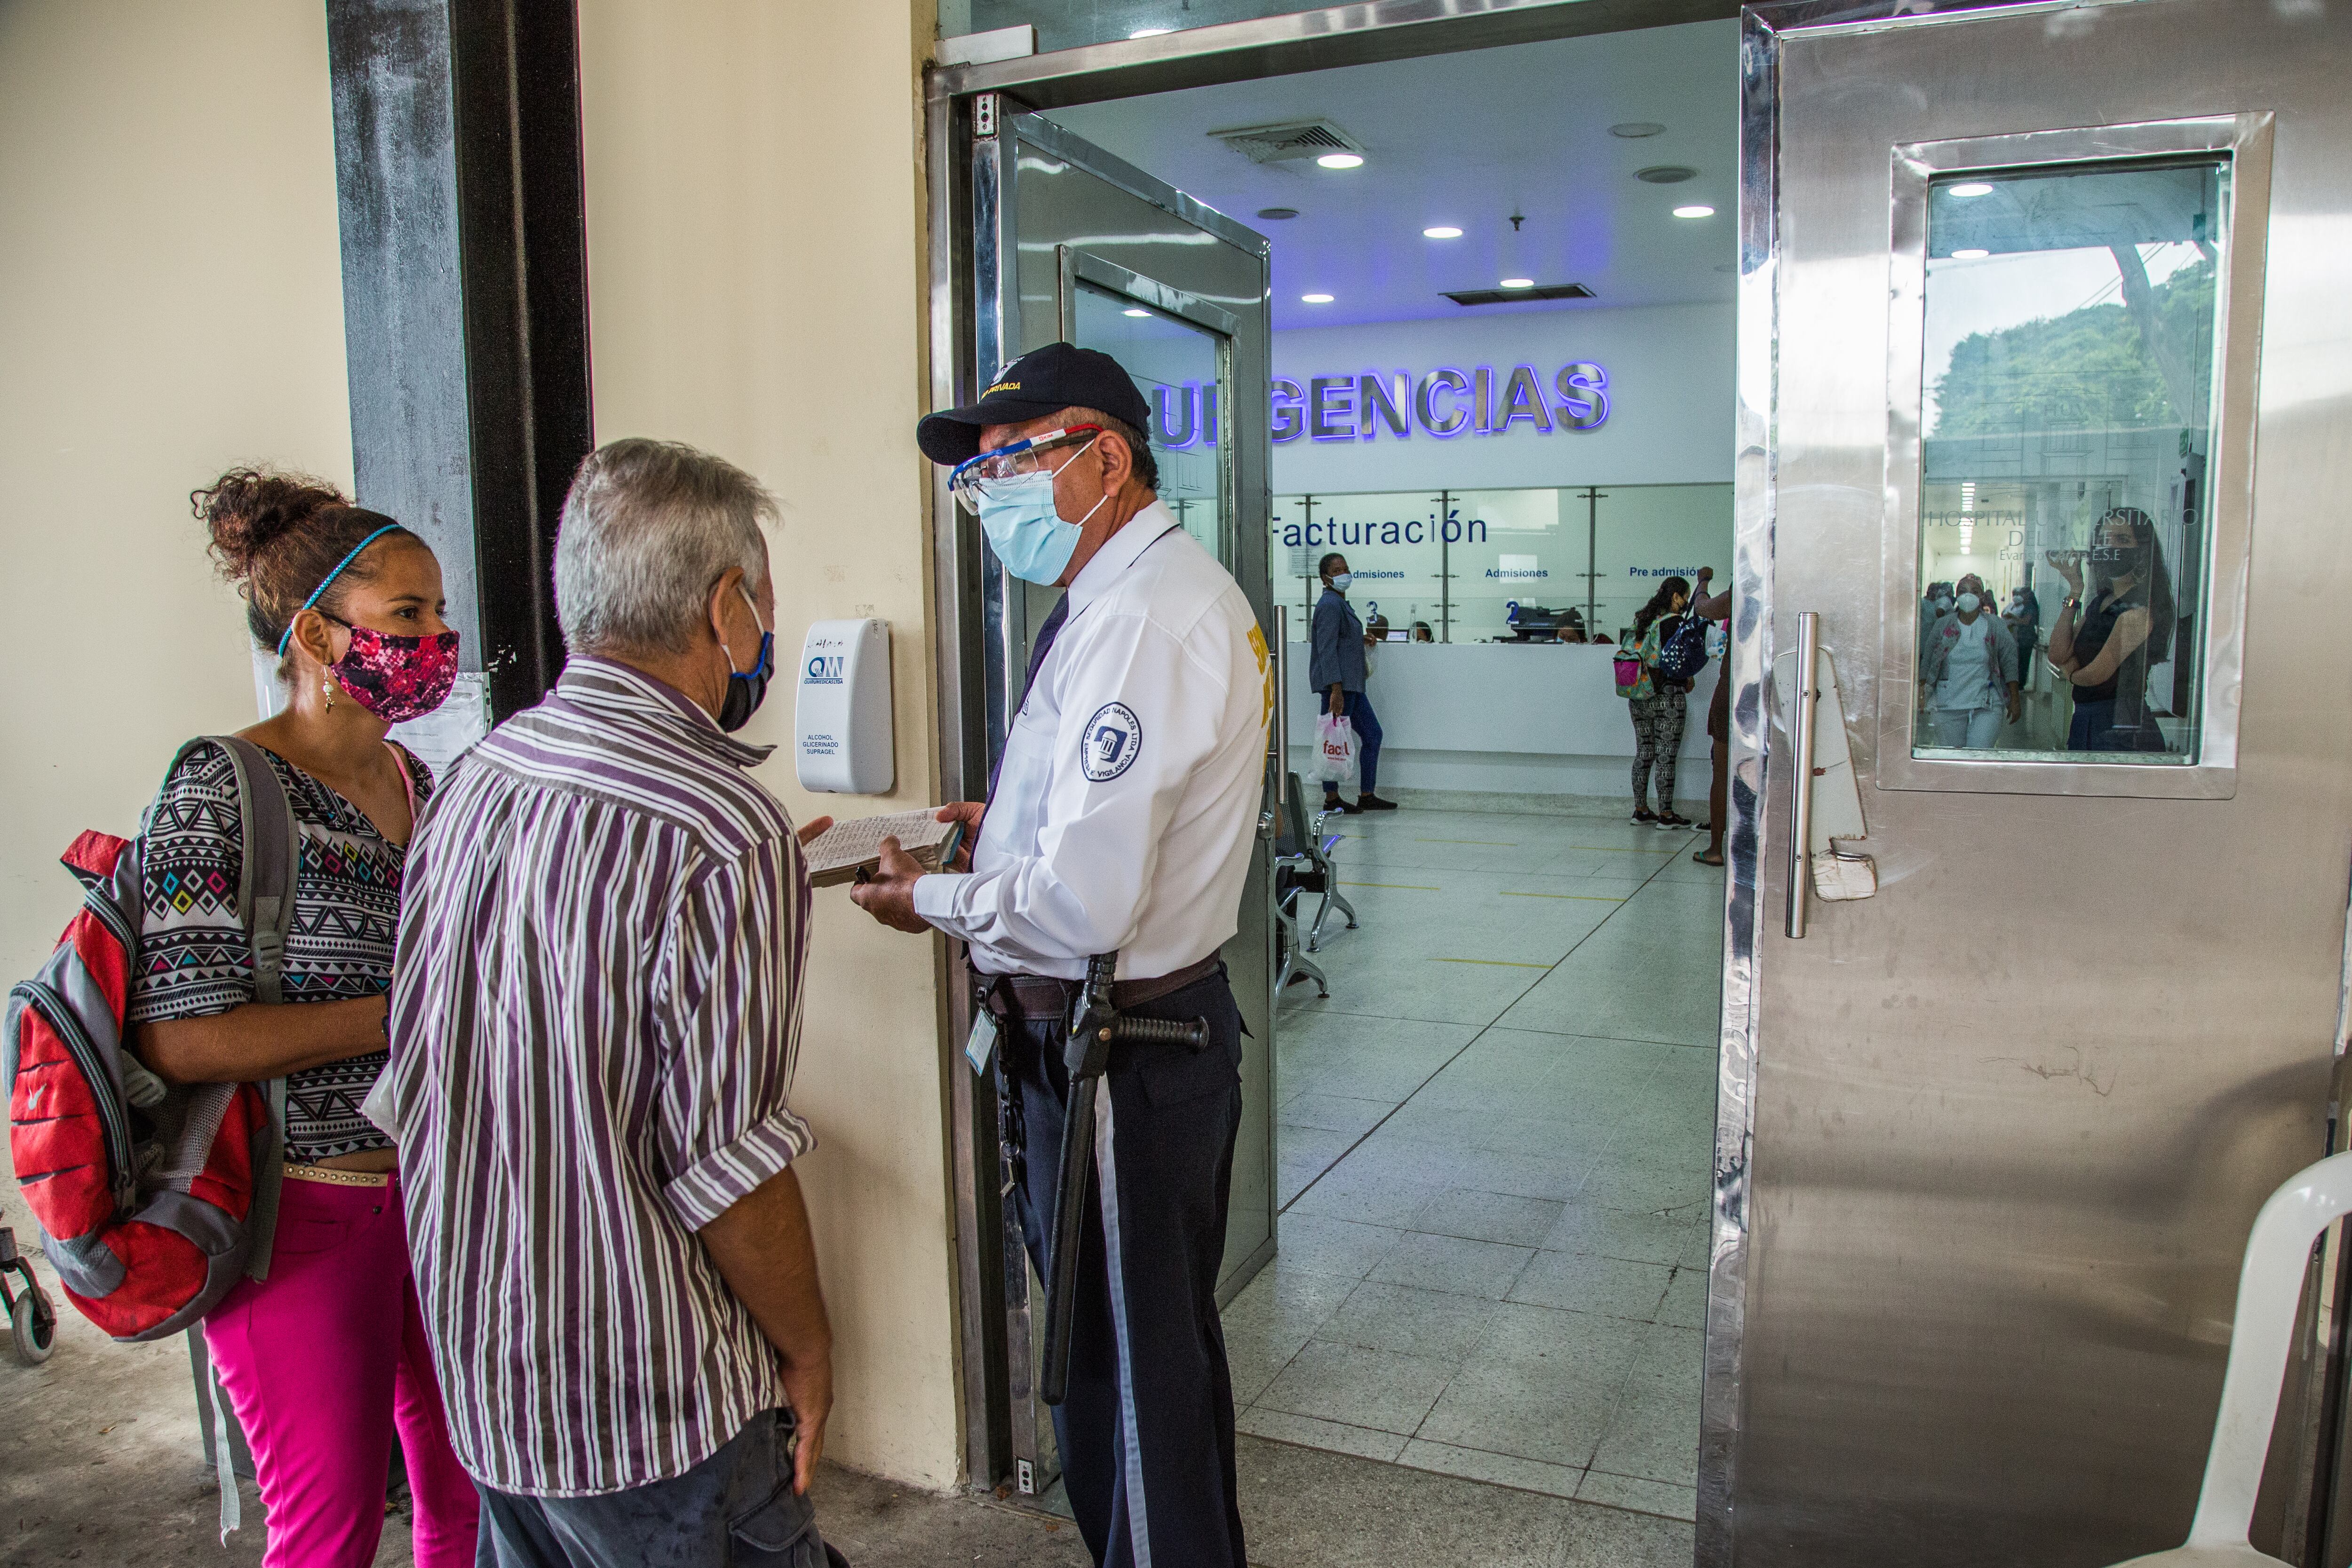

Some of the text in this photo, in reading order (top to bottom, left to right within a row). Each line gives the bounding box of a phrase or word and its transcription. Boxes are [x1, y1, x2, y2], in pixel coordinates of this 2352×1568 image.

[1152, 363, 1608, 446] UGENCIAS
[1929, 510, 2026, 527] HOSPITAL
[2009, 531, 2047, 546] DEL
[1351, 570, 1405, 578] dmisiones
[1485, 568, 1548, 578] Admisiones
[1630, 567, 1648, 577] Pre
[1366, 601, 1378, 624] 3
[1506, 601, 1520, 625] 2
[1086, 707, 1137, 752] SEGURIDAD NAPOLES LTDA
[1097, 754, 1131, 777] VIGILANCIA
